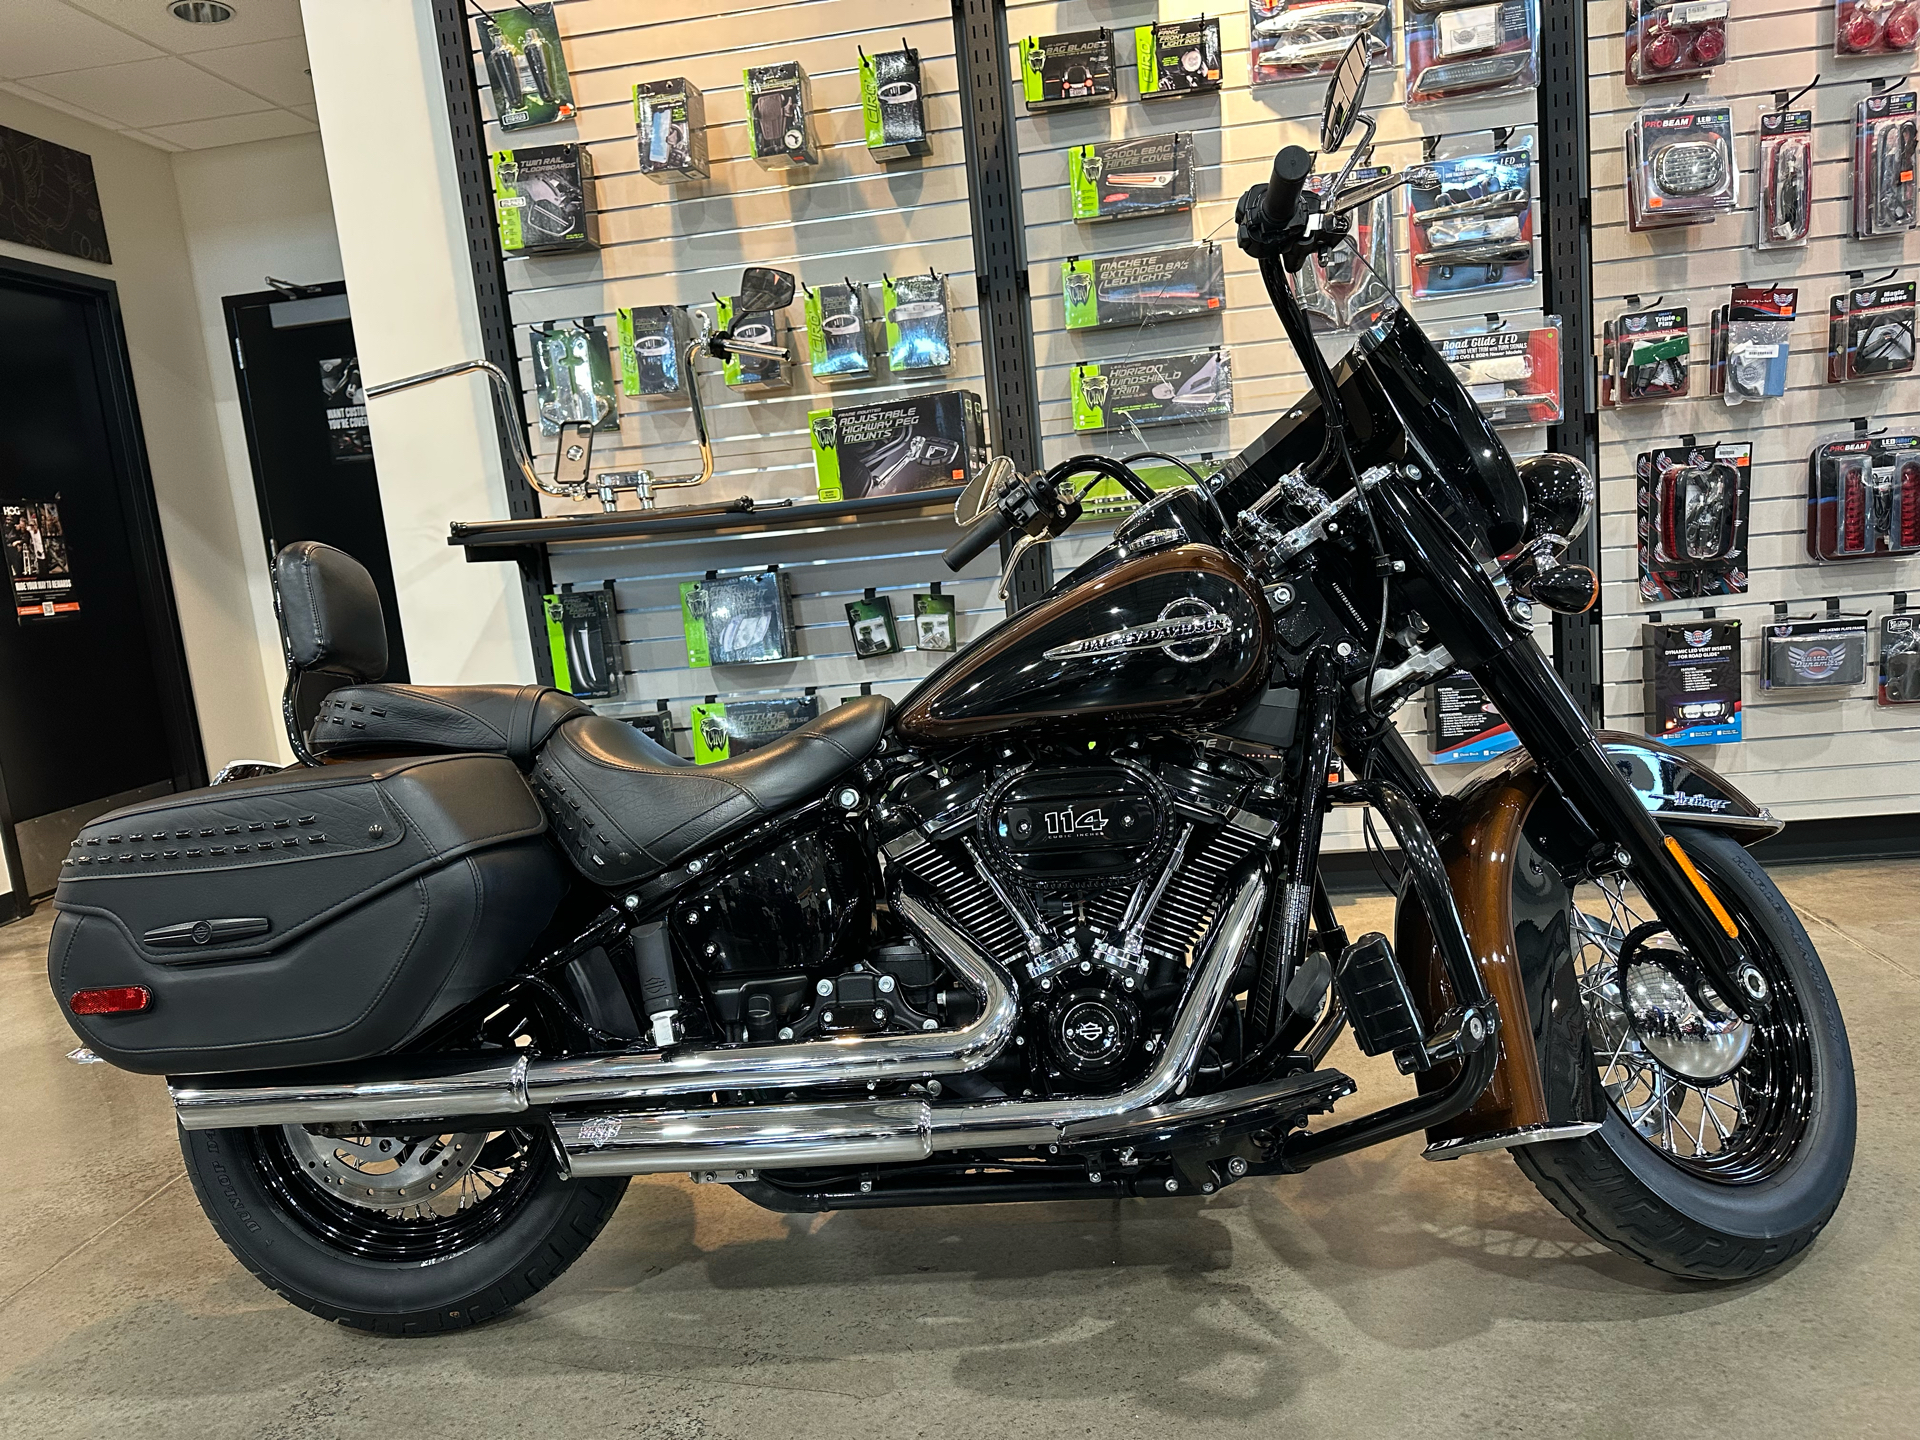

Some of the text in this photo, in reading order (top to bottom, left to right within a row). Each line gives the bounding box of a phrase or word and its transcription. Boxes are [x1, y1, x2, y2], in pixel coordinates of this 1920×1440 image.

[1159, 34, 1184, 43] FRONT
[1162, 40, 1182, 48] LIGHT
[1046, 42, 1107, 54] BAG BLADES
[1140, 40, 1153, 83] CIRO
[866, 82, 879, 124] CIRO
[1644, 118, 1689, 128] PROBEAM
[1103, 144, 1171, 160] SADDLEBAG
[520, 157, 564, 167] TWIN RAIL
[1106, 151, 1186, 169] HINGE COVERS
[520, 162, 576, 174] FLOORBOARDS
[1100, 257, 1158, 271] MACHETE
[1100, 261, 1189, 279] EXTENDED BAG
[1103, 272, 1173, 287] LED LIGHTS
[1880, 295, 1907, 303] Strobes
[810, 314, 821, 354] CIRO
[1443, 334, 1518, 350] Road Glide LED
[1109, 366, 1163, 378] HORIZON
[1111, 372, 1182, 386] WINDSHIELD
[1112, 386, 1140, 395] TRIM
[839, 408, 917, 425] ADJUSTABLE
[856, 408, 882, 416] MOUNTED
[842, 416, 919, 435] HIGHWAY PEG
[844, 429, 892, 443] MOUNTS
[1829, 443, 1867, 452] PROBEAM
[3, 506, 20, 516] HOG
[1080, 620, 1223, 651] HARLEY-DAVIDSON
[1674, 791, 1724, 812] Heritage
[1045, 808, 1109, 834] 114
[1732, 856, 1840, 1043] HARLEY-DAVIDSON
[212, 1160, 261, 1233] DUNLOP
